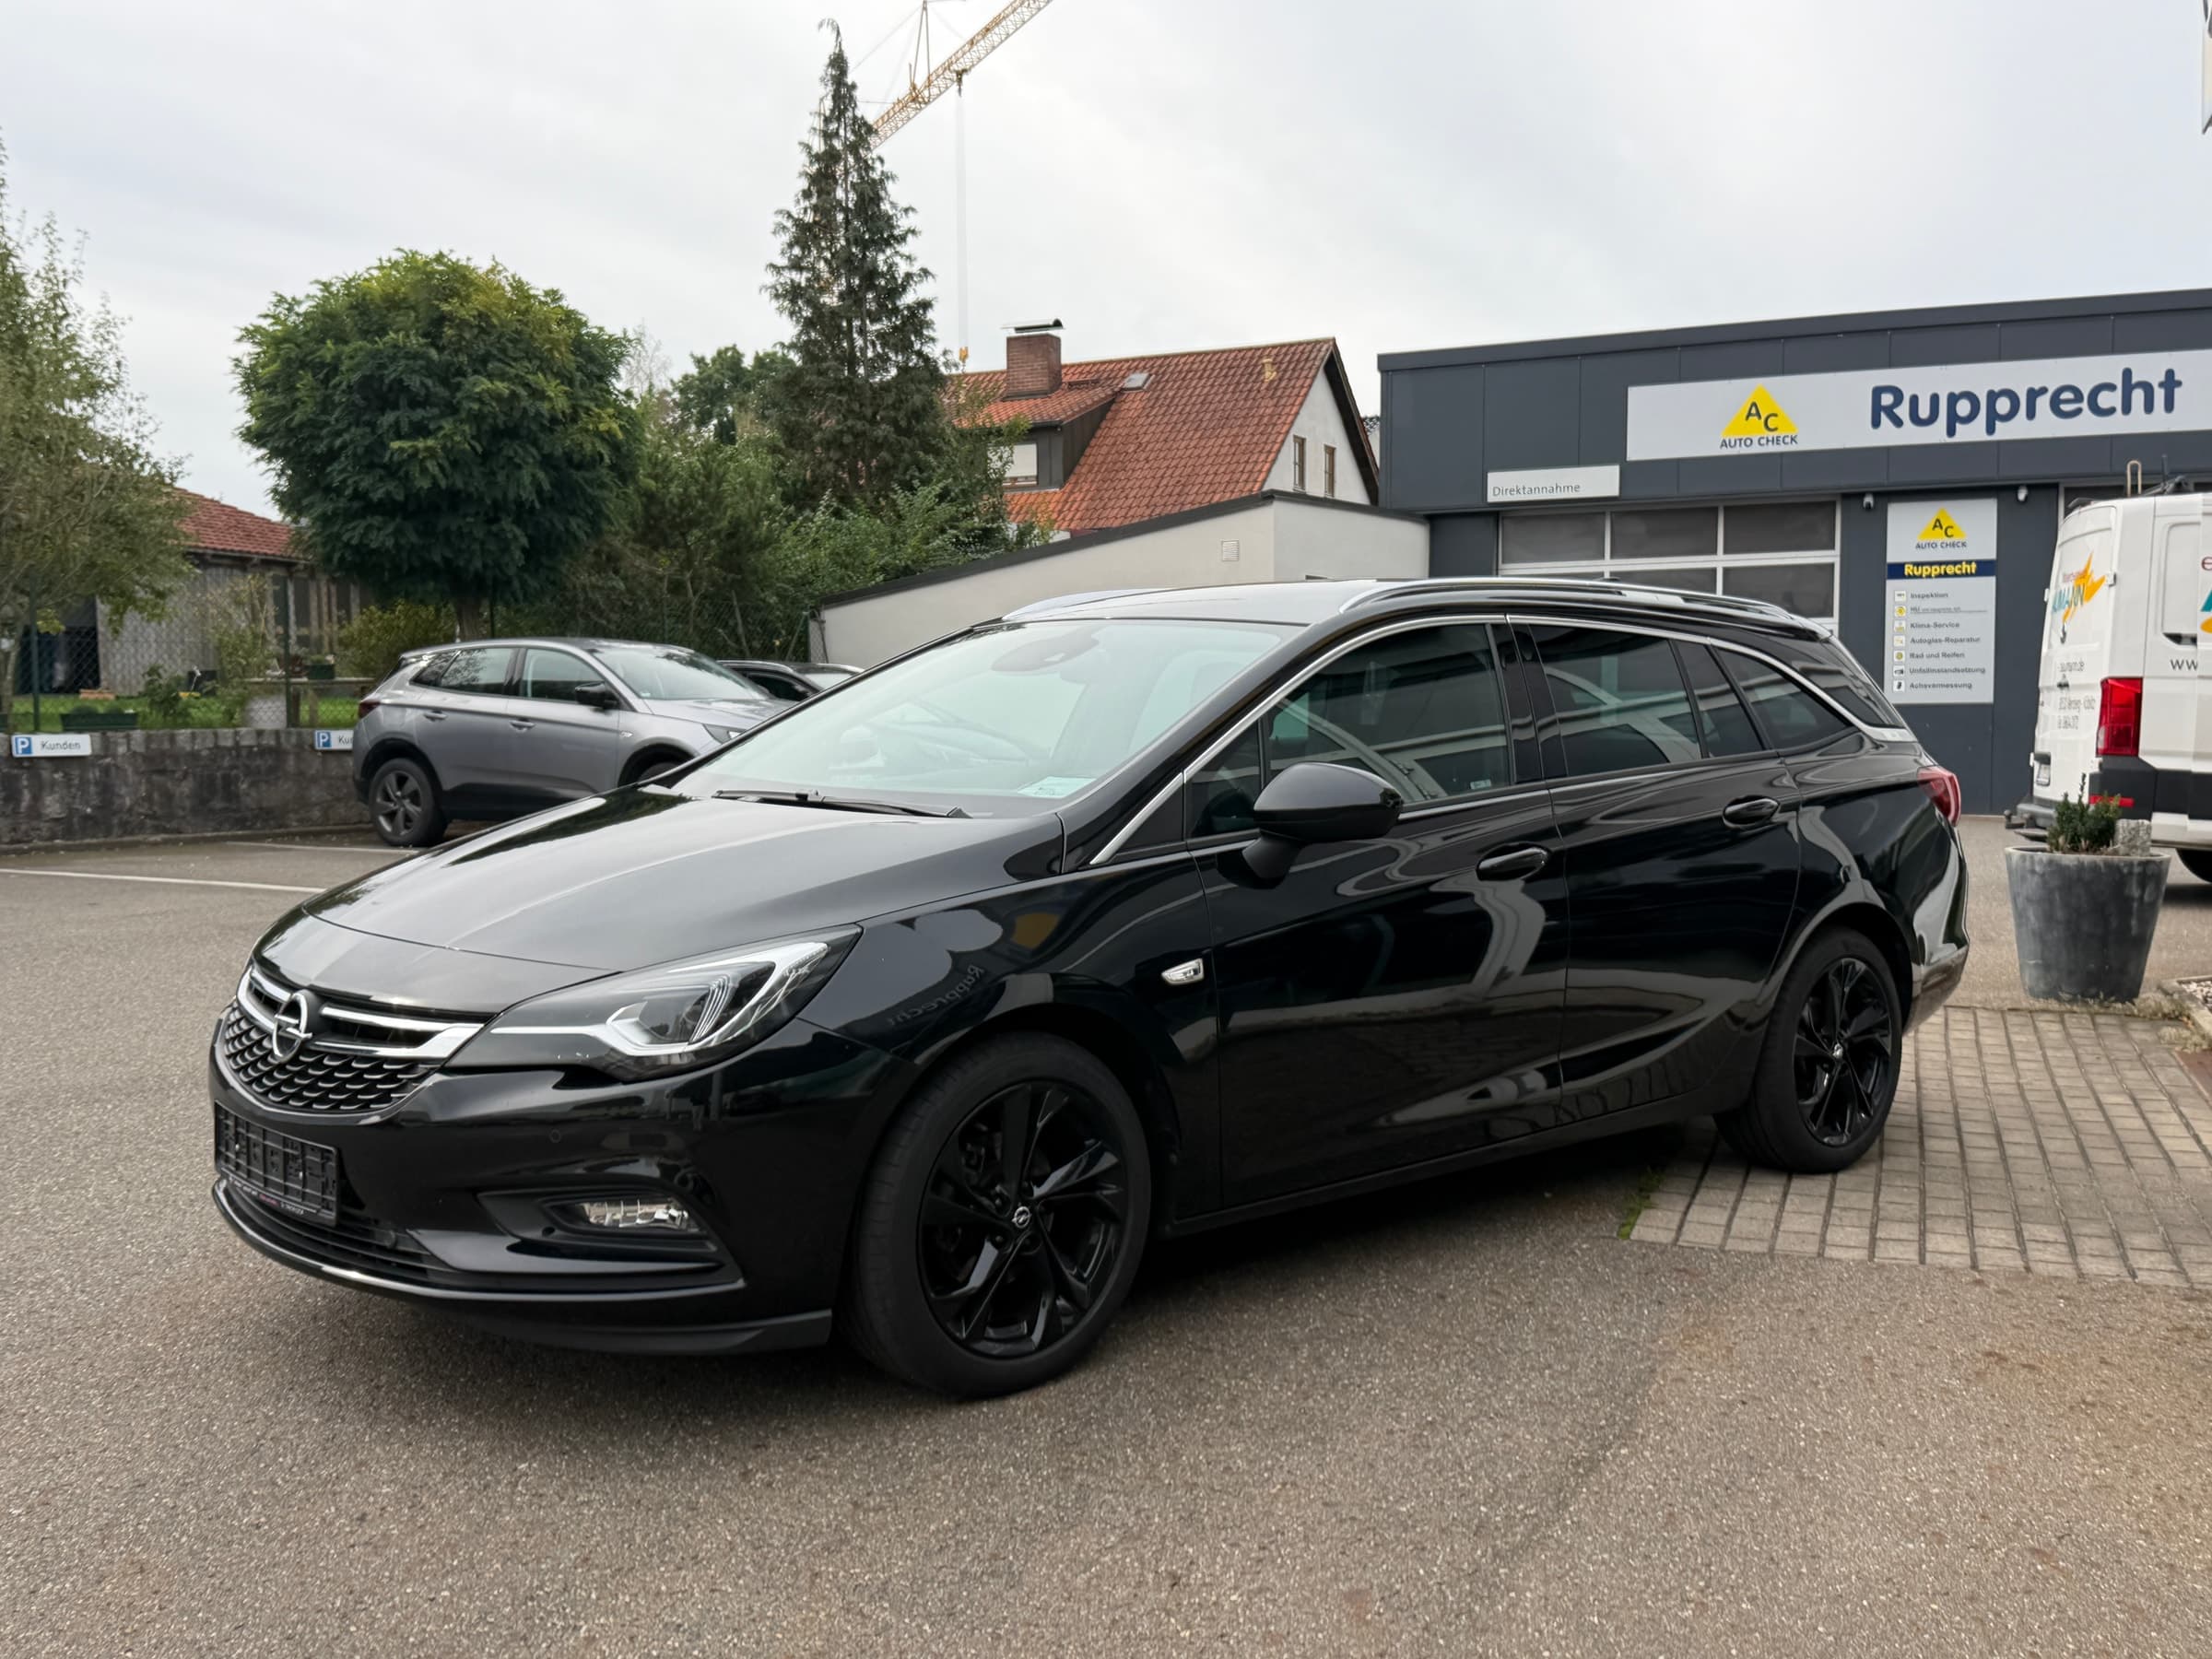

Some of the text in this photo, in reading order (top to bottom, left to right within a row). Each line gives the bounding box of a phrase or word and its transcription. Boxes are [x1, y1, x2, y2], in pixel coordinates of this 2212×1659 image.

[1871, 367, 2183, 438] Rupprecht
[1720, 435, 1798, 450] AUTO CHECK
[1492, 483, 1581, 497] Direktannahme
[1904, 561, 1976, 578] Rupprecht
[1909, 666, 1986, 675] Unfallinstandsetzung
[1909, 682, 1972, 690] Achsvermessung
[18, 737, 81, 754] P Kunden
